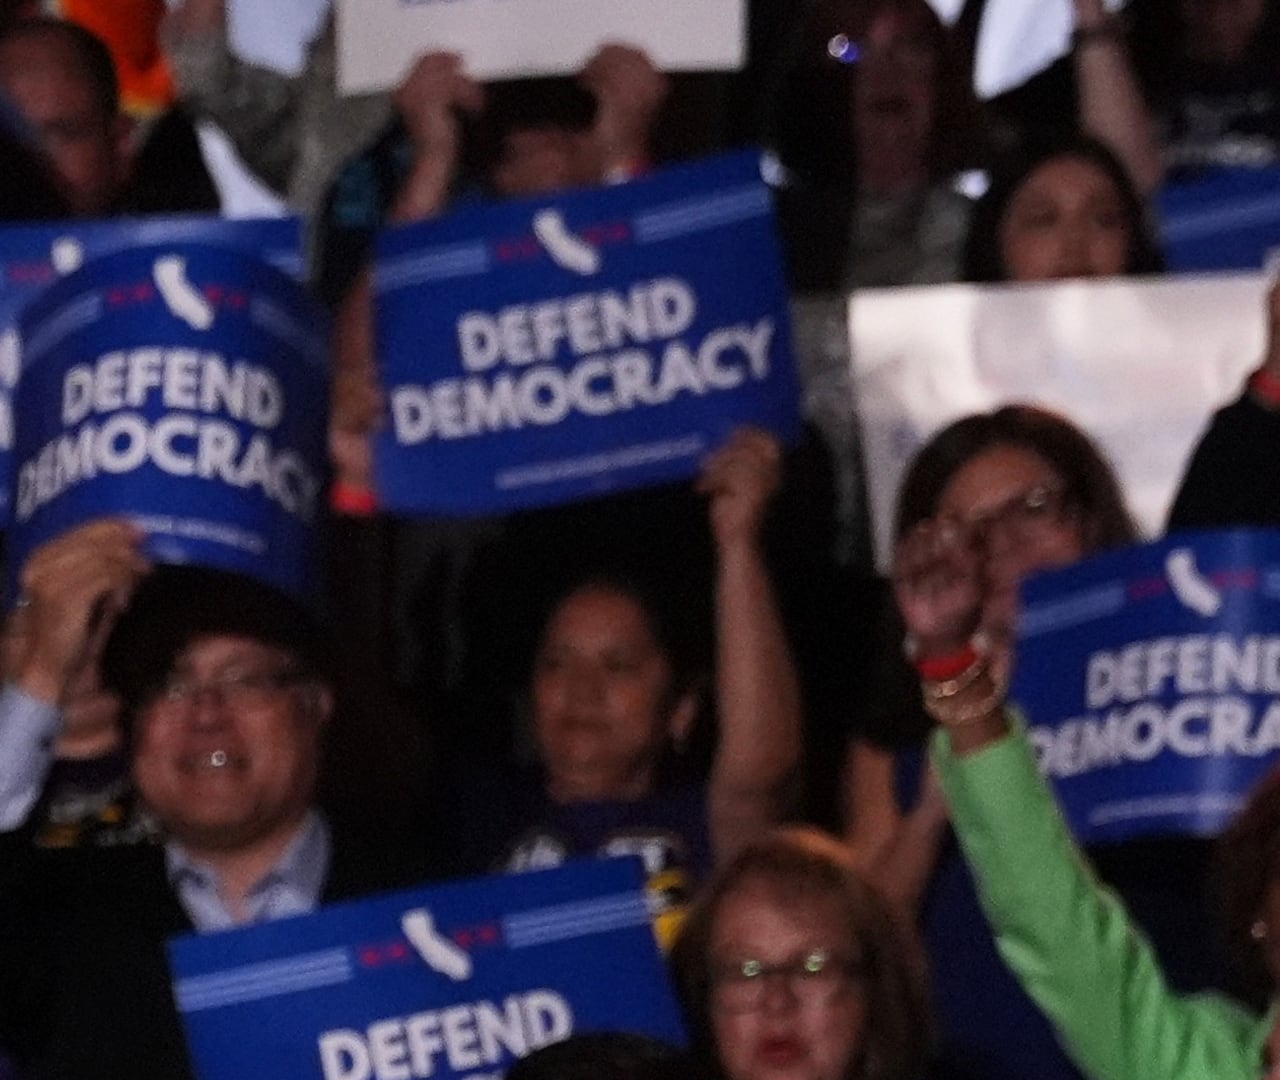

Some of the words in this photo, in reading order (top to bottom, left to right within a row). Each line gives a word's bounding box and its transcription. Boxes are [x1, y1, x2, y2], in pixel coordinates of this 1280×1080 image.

[458, 277, 696, 373] DEFEND
[63, 346, 283, 428] DEFEND
[392, 317, 773, 446] DEMOCRACY
[17, 412, 312, 522] DEMOCRAC
